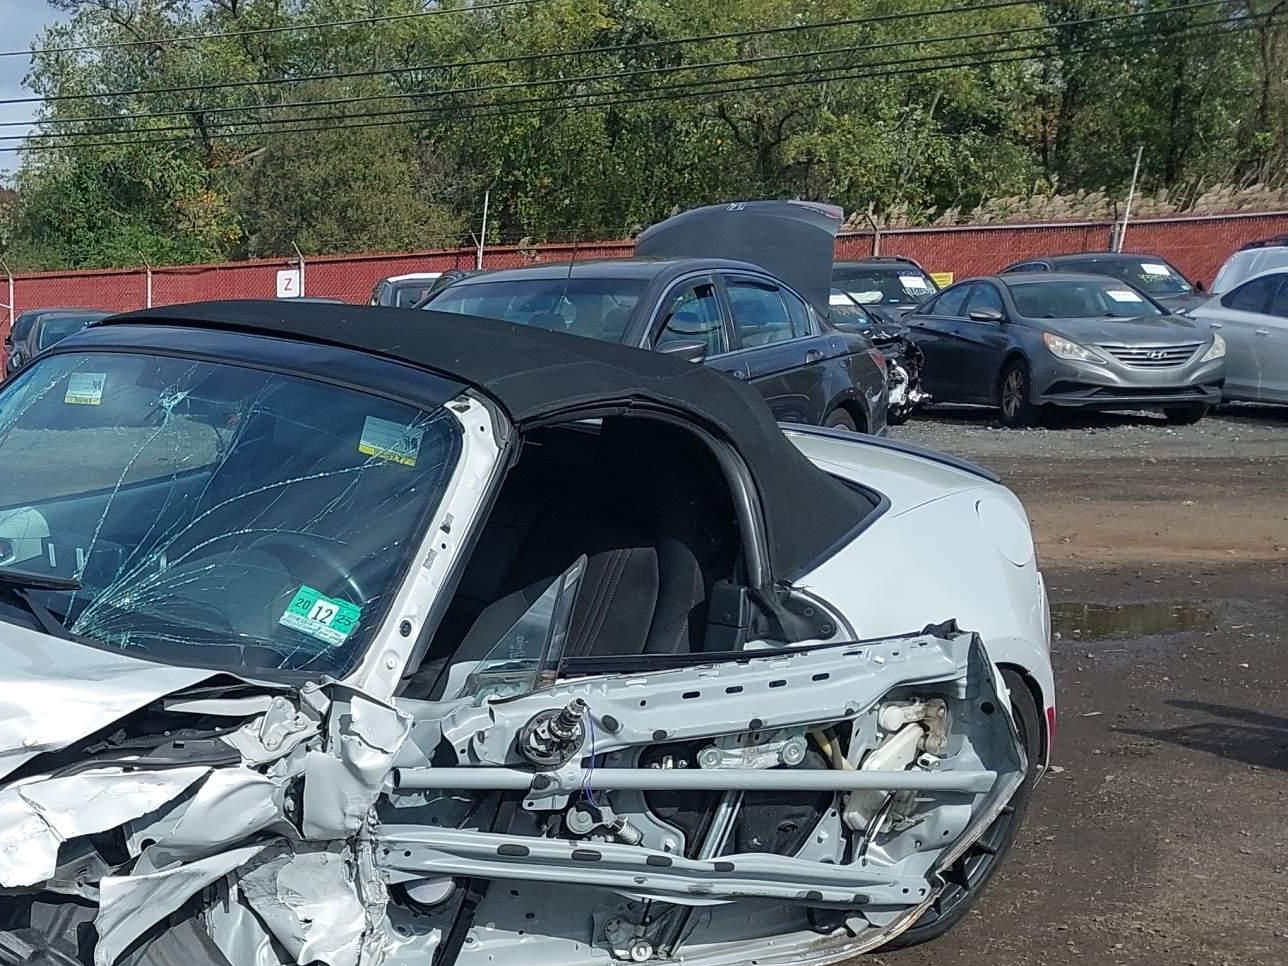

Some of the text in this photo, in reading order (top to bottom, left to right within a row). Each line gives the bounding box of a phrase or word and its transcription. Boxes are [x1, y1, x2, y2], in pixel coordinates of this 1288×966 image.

[284, 277, 293, 291] Z
[294, 597, 312, 610] 20
[311, 605, 334, 625] 12
[335, 614, 354, 627] 25
